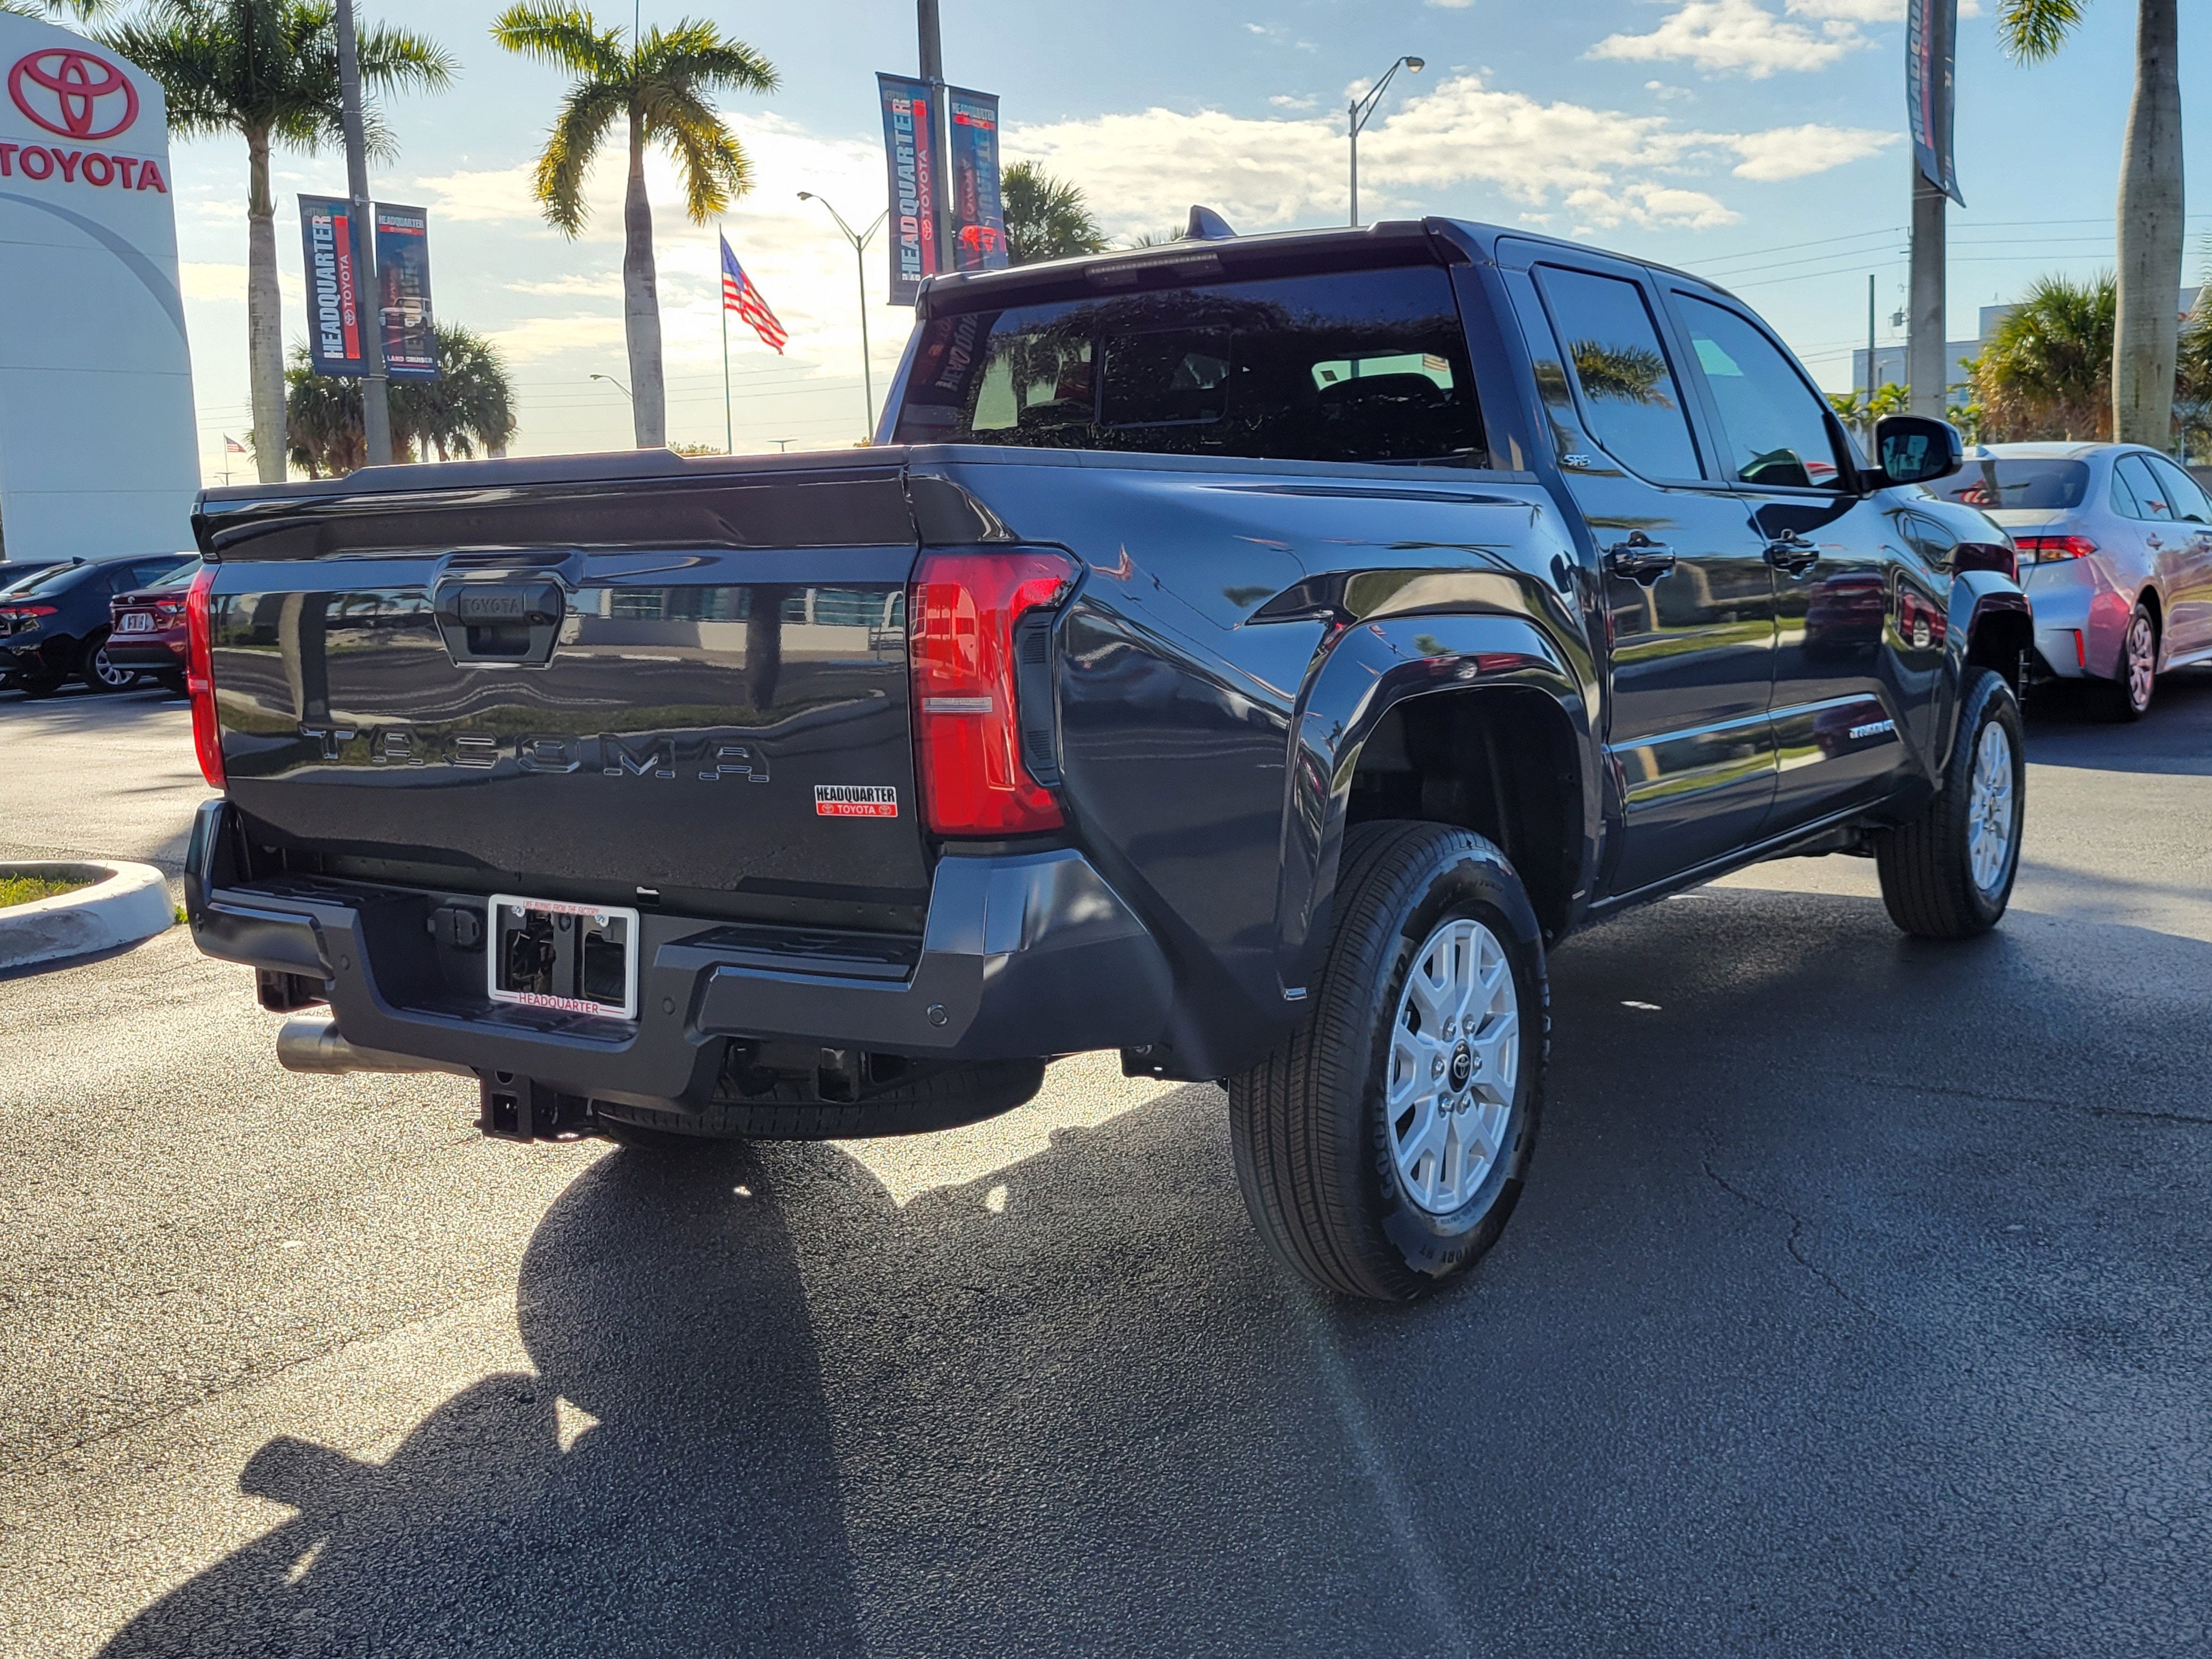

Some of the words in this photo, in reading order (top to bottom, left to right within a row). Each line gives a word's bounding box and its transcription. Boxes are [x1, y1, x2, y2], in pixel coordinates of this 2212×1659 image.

[0, 143, 167, 193] TOYOTA
[893, 98, 921, 281] HEADQUARTER
[917, 150, 930, 218] TOYOTA
[312, 215, 344, 359] HEADQUARTER
[339, 255, 355, 307] TOYOTA
[464, 599, 520, 613] TOYOTA
[300, 721, 769, 782] TACOMA
[816, 786, 895, 803] HEADQUARTER
[837, 805, 876, 814] TOYOTA
[519, 994, 599, 1014] HEADQUARTER
